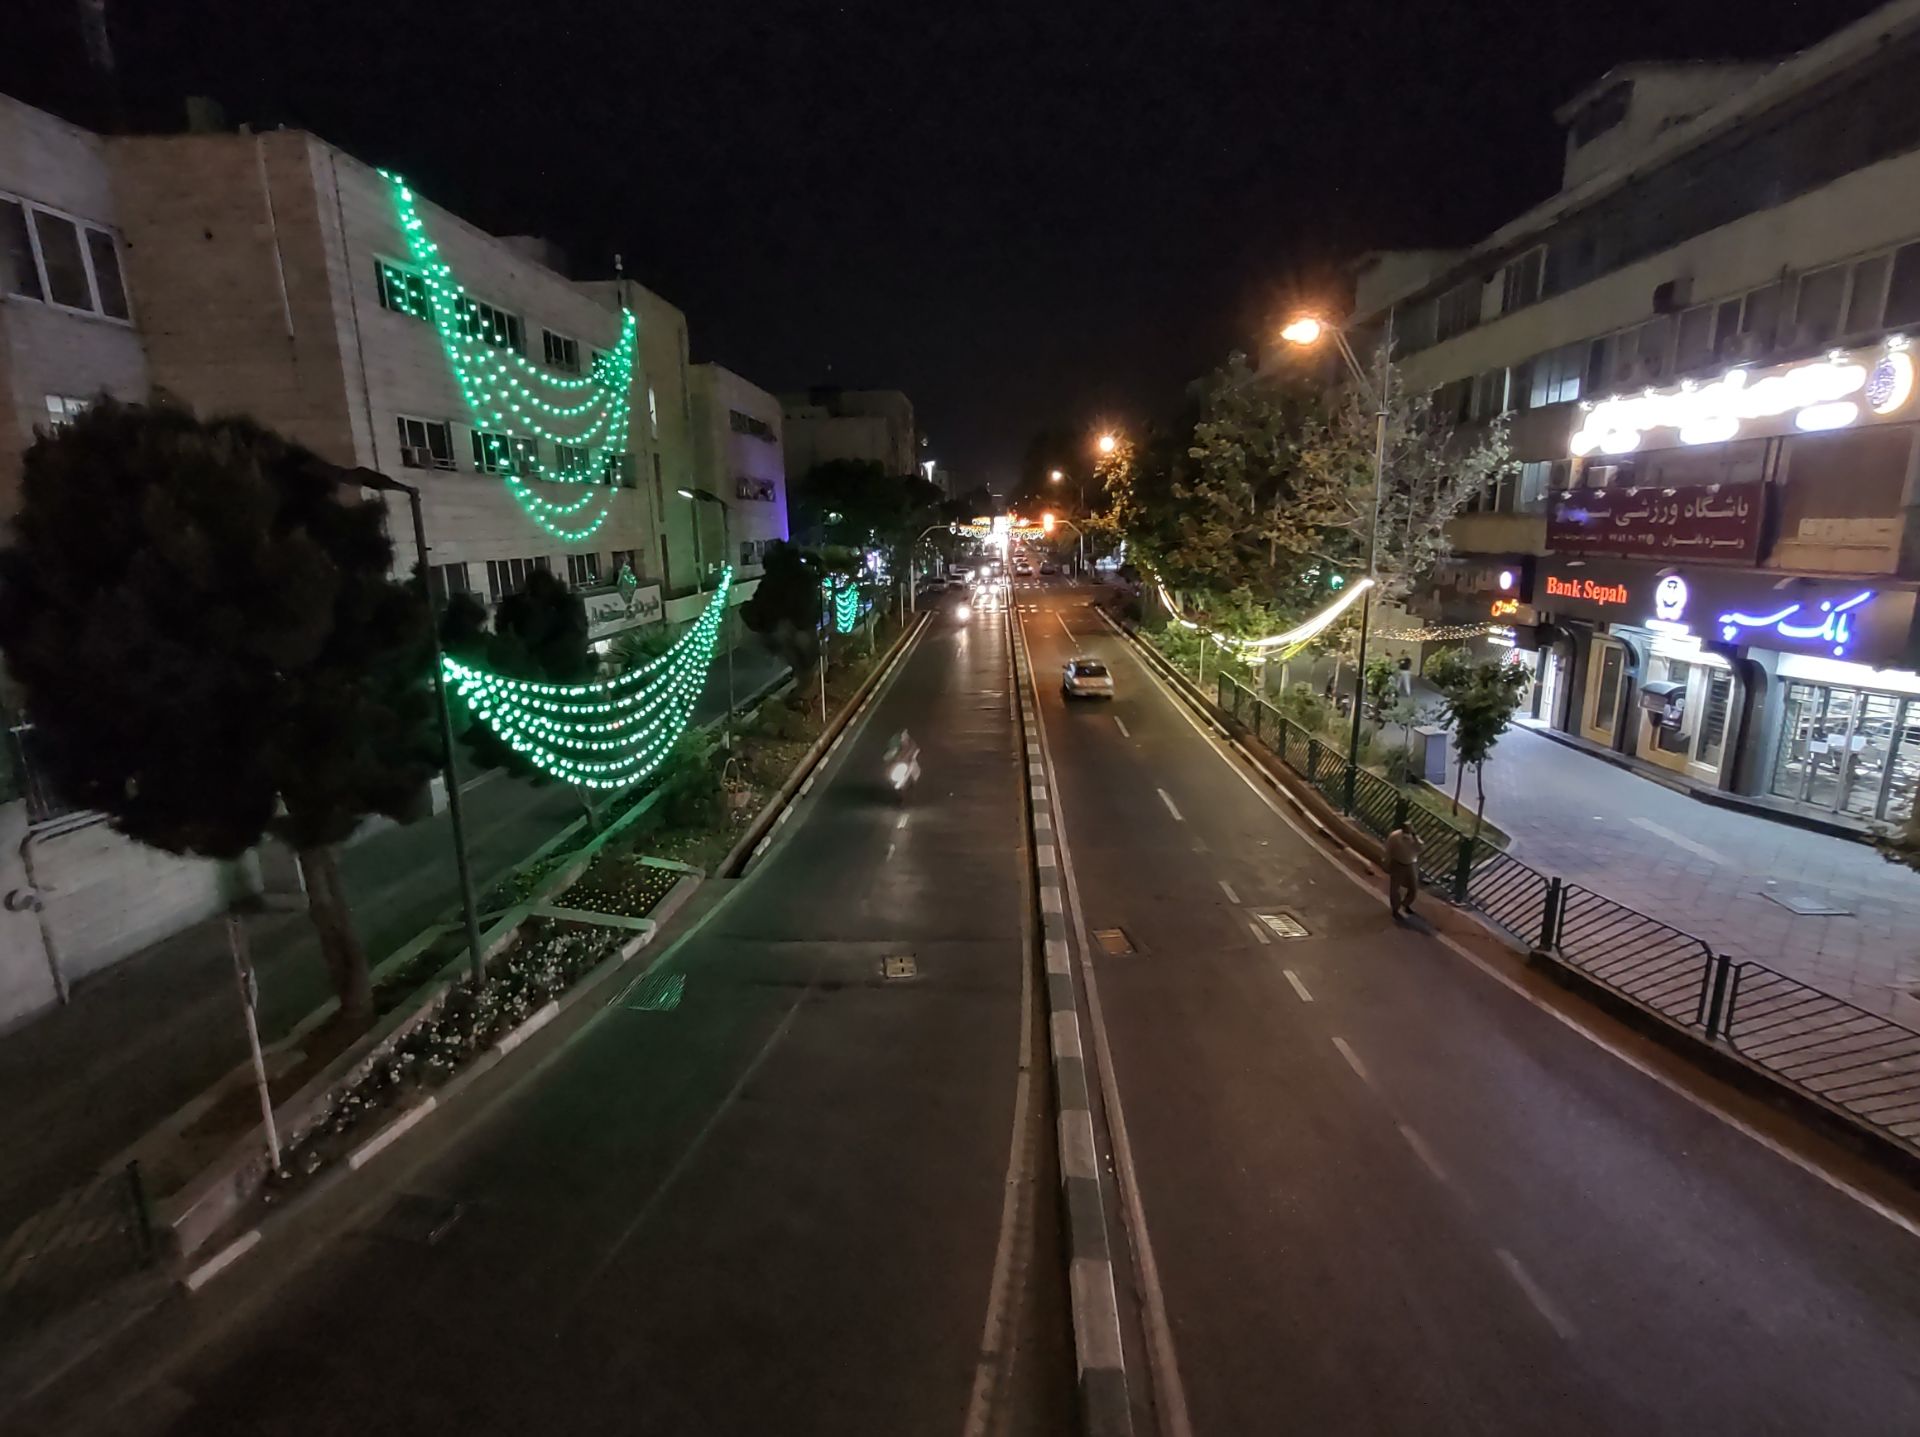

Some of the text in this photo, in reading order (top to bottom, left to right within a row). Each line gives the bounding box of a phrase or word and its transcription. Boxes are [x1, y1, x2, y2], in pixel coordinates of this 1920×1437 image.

[1615, 499, 1679, 527] ورزشی
[1684, 496, 1749, 524] باشگاه
[1546, 576, 1628, 606] Bank Sepah
[1717, 590, 1872, 657] بانک سپه
